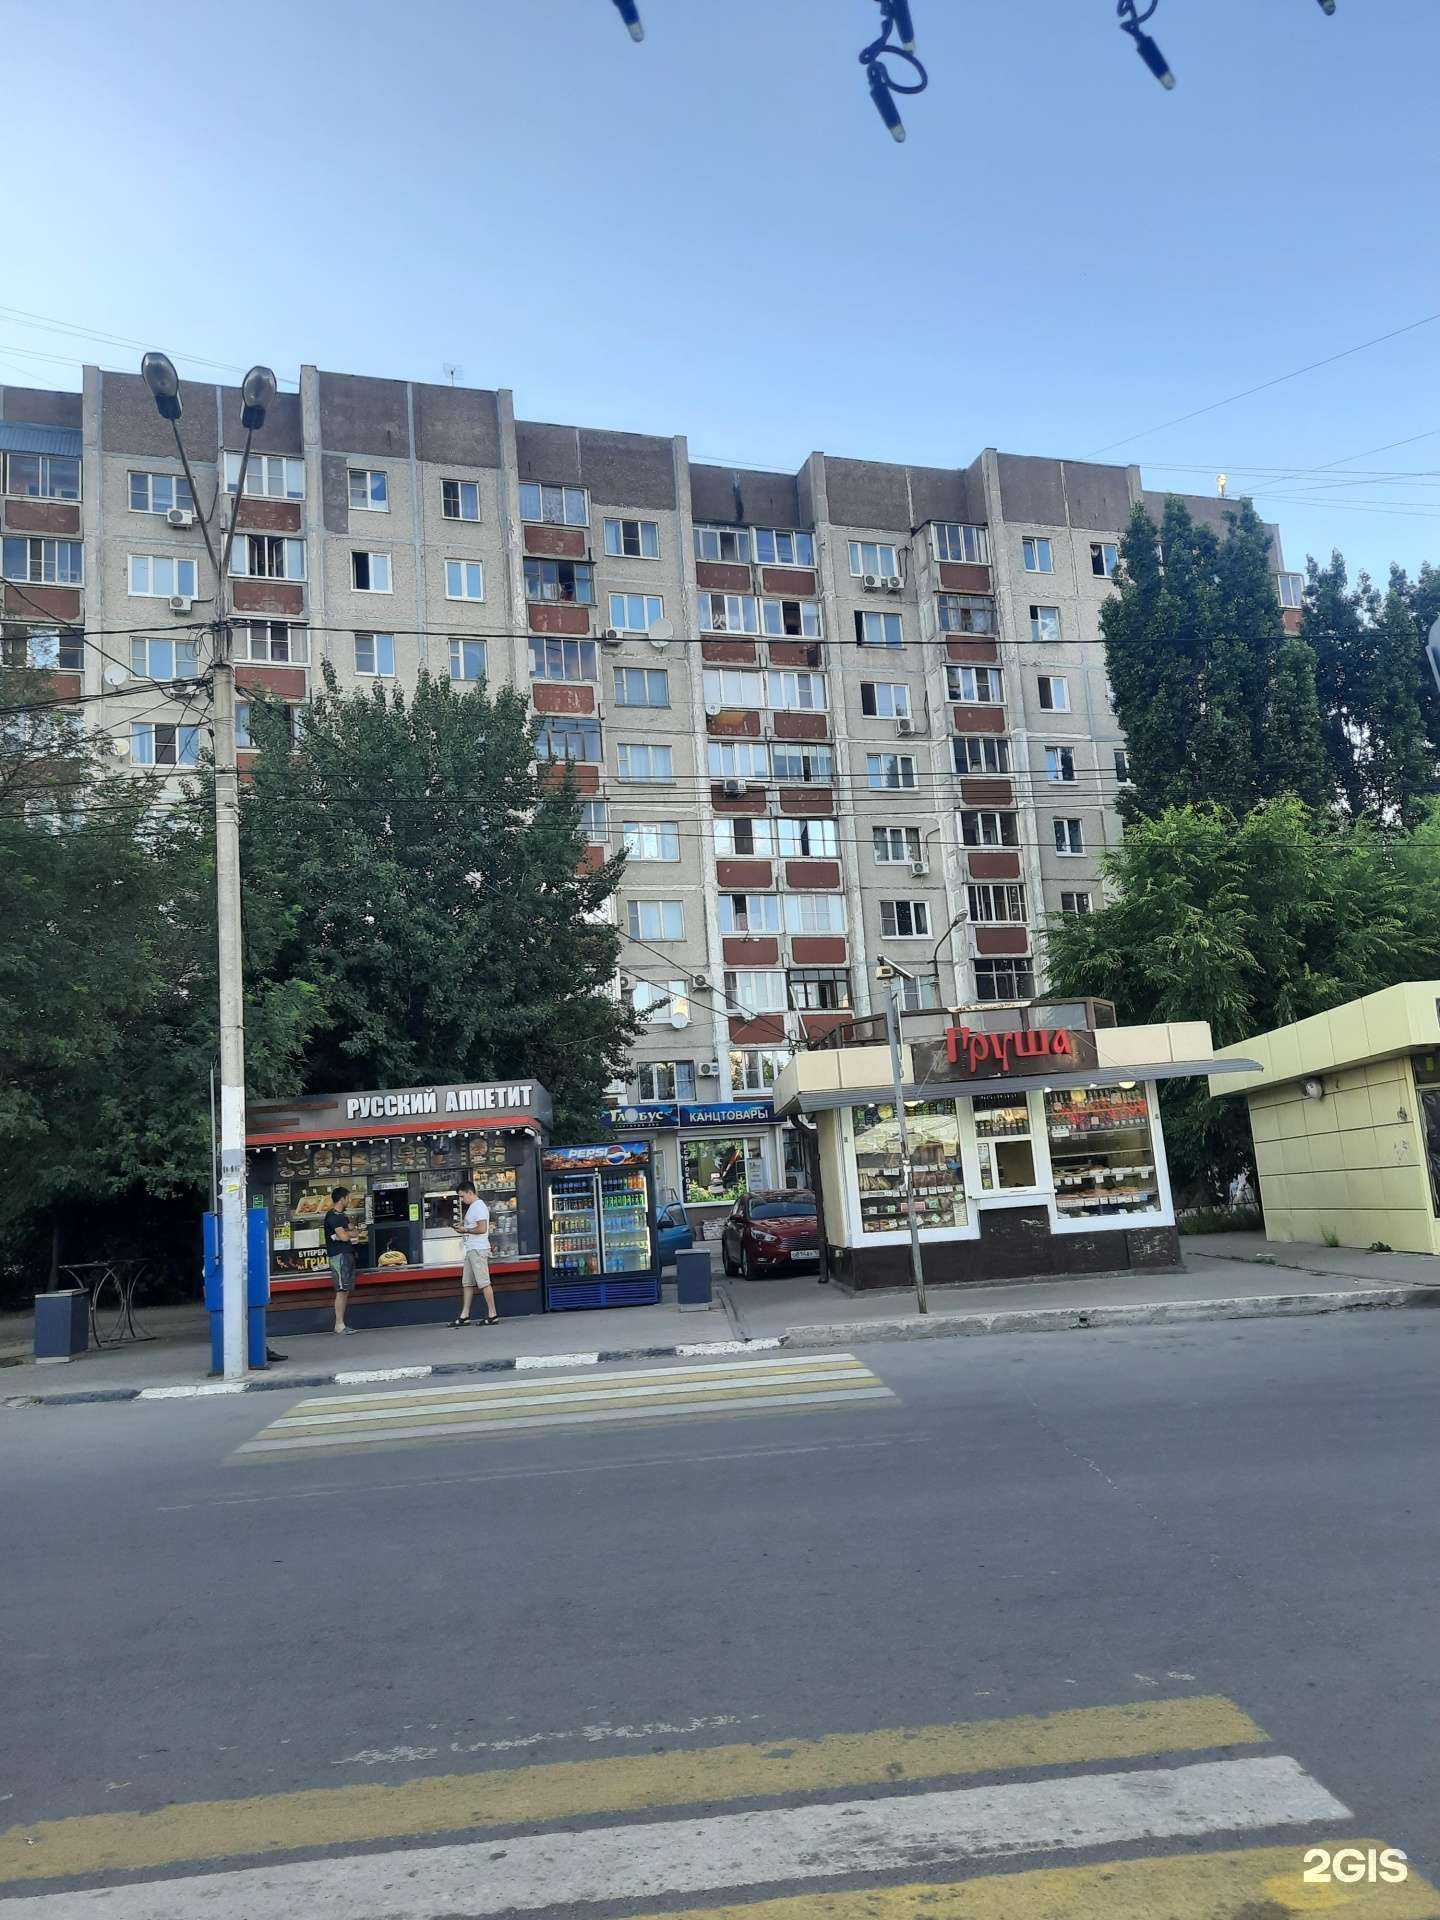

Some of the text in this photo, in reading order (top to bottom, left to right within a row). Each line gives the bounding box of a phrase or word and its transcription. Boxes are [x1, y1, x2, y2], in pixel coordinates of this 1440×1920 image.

[945, 1026, 1073, 1073] Груша
[346, 1085, 533, 1119] РУССКИЙ АППЕТИТ
[689, 1109, 769, 1122] КАНЦТОВАРЫ
[568, 1147, 608, 1159] PEPSI
